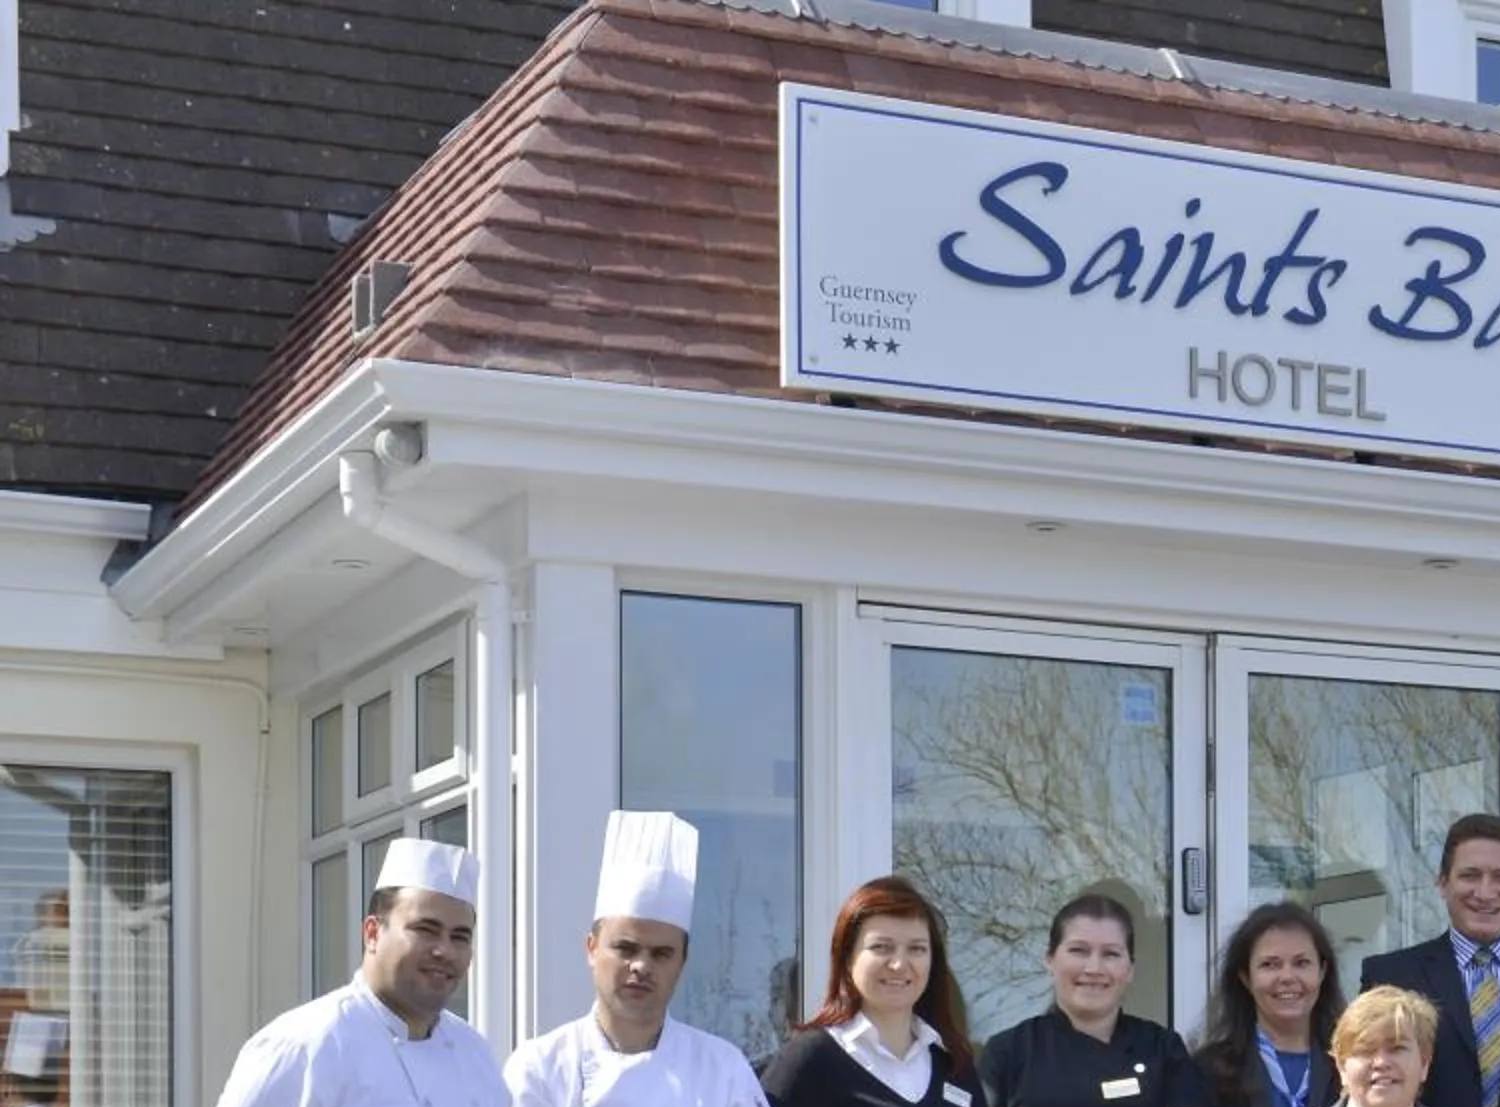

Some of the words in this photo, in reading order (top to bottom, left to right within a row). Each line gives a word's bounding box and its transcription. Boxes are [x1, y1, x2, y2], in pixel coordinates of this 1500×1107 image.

[937, 160, 1348, 328] Saints
[819, 275, 918, 314] Guernsey
[824, 300, 912, 331] Tourism
[1187, 345, 1388, 423] HOTEL
